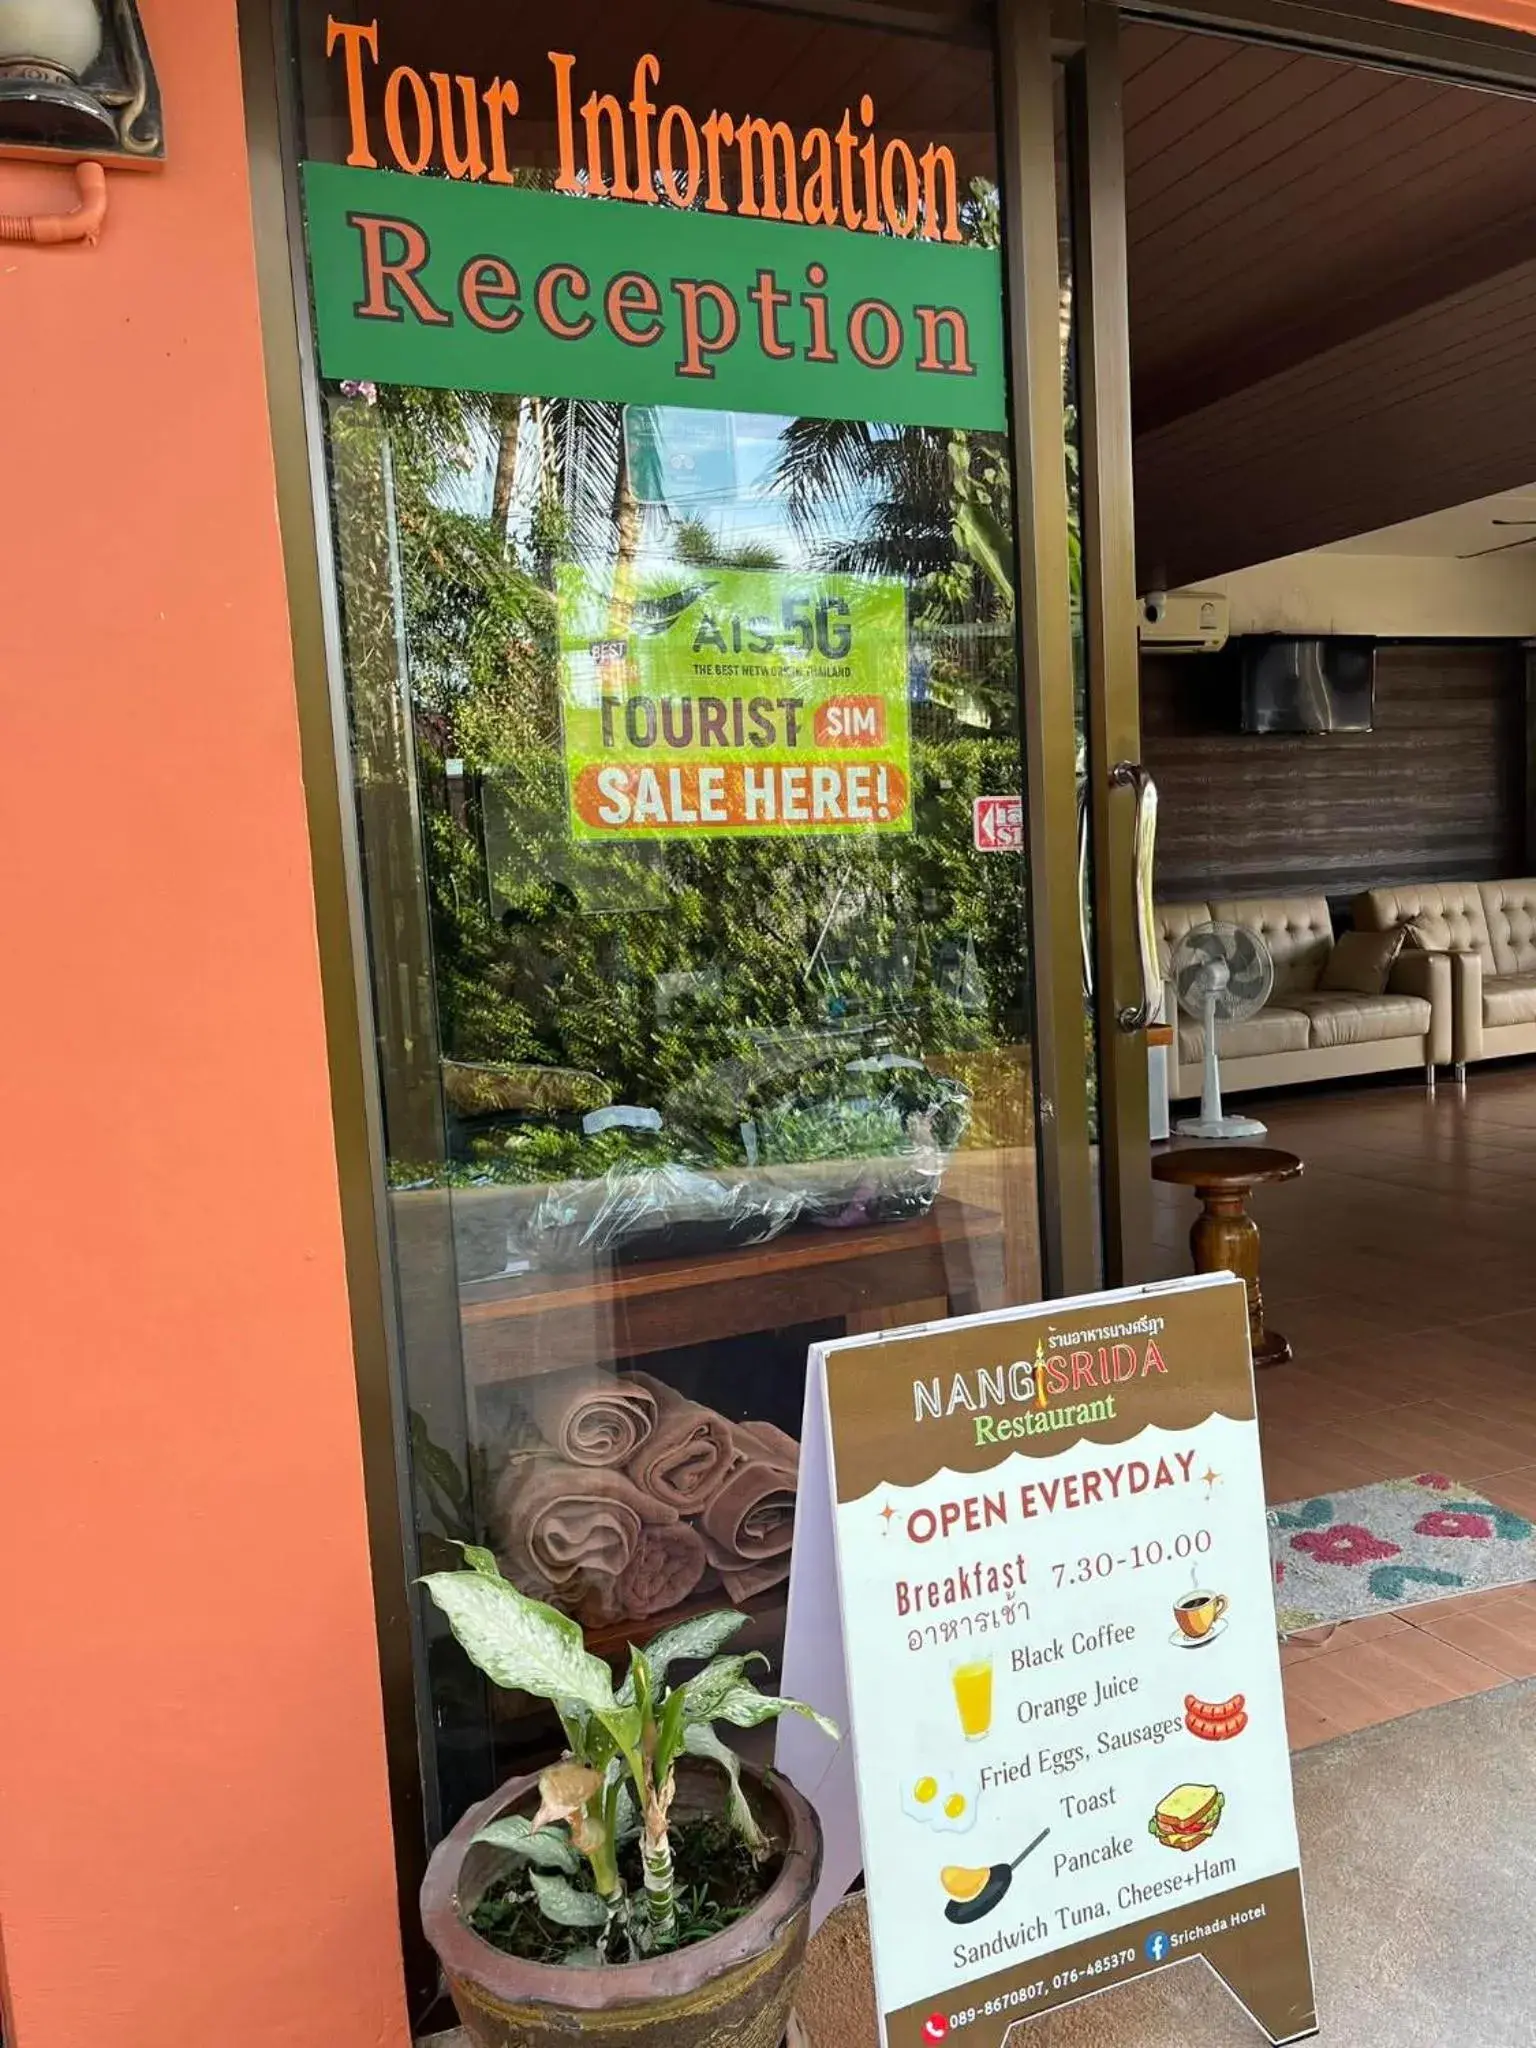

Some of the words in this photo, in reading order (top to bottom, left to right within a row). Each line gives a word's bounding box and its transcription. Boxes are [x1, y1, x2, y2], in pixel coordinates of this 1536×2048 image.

[326, 14, 519, 184] Tour
[547, 51, 963, 242] Information
[346, 210, 978, 379] Reception
[692, 612, 775, 654] AIS
[693, 664, 712, 675] THE
[715, 664, 739, 676] BEST
[602, 696, 803, 748] TOURIST
[826, 707, 877, 737] SIM
[597, 767, 728, 825] SALE
[744, 766, 890, 820] HERE!
[913, 1361, 1035, 1421] NANG
[1045, 1338, 1168, 1394] SRIDA
[972, 1395, 1117, 1446] Restaurant
[907, 1490, 1007, 1544] OPEN
[1022, 1449, 1197, 1519] EVERYDAY
[895, 1555, 1027, 1616] Breakfast
[1052, 1529, 1212, 1589] 7.30-10.00
[907, 1591, 1031, 1651] อาหารเช้า
[1011, 1640, 1065, 1672] Black
[1072, 1622, 1136, 1655] Coffee
[1017, 1691, 1088, 1724] Orange
[1094, 1674, 1139, 1707] Juice
[979, 1753, 1032, 1791] Fried
[1038, 1744, 1091, 1775] Eggs,
[1097, 1714, 1184, 1755] Sausages
[1060, 1785, 1117, 1820] Toast
[1053, 1835, 1134, 1878] Pancake
[953, 1917, 1049, 1969] Sandwich
[1055, 1901, 1111, 1931] Tuna,
[1117, 1855, 1237, 1911] Cheese+Ham
[1170, 1920, 1228, 1947] Srichada
[1230, 1904, 1267, 1926] Hotel
[949, 1981, 1049, 2029] 089-8670807,
[1052, 1947, 1136, 1989] 076-485370
